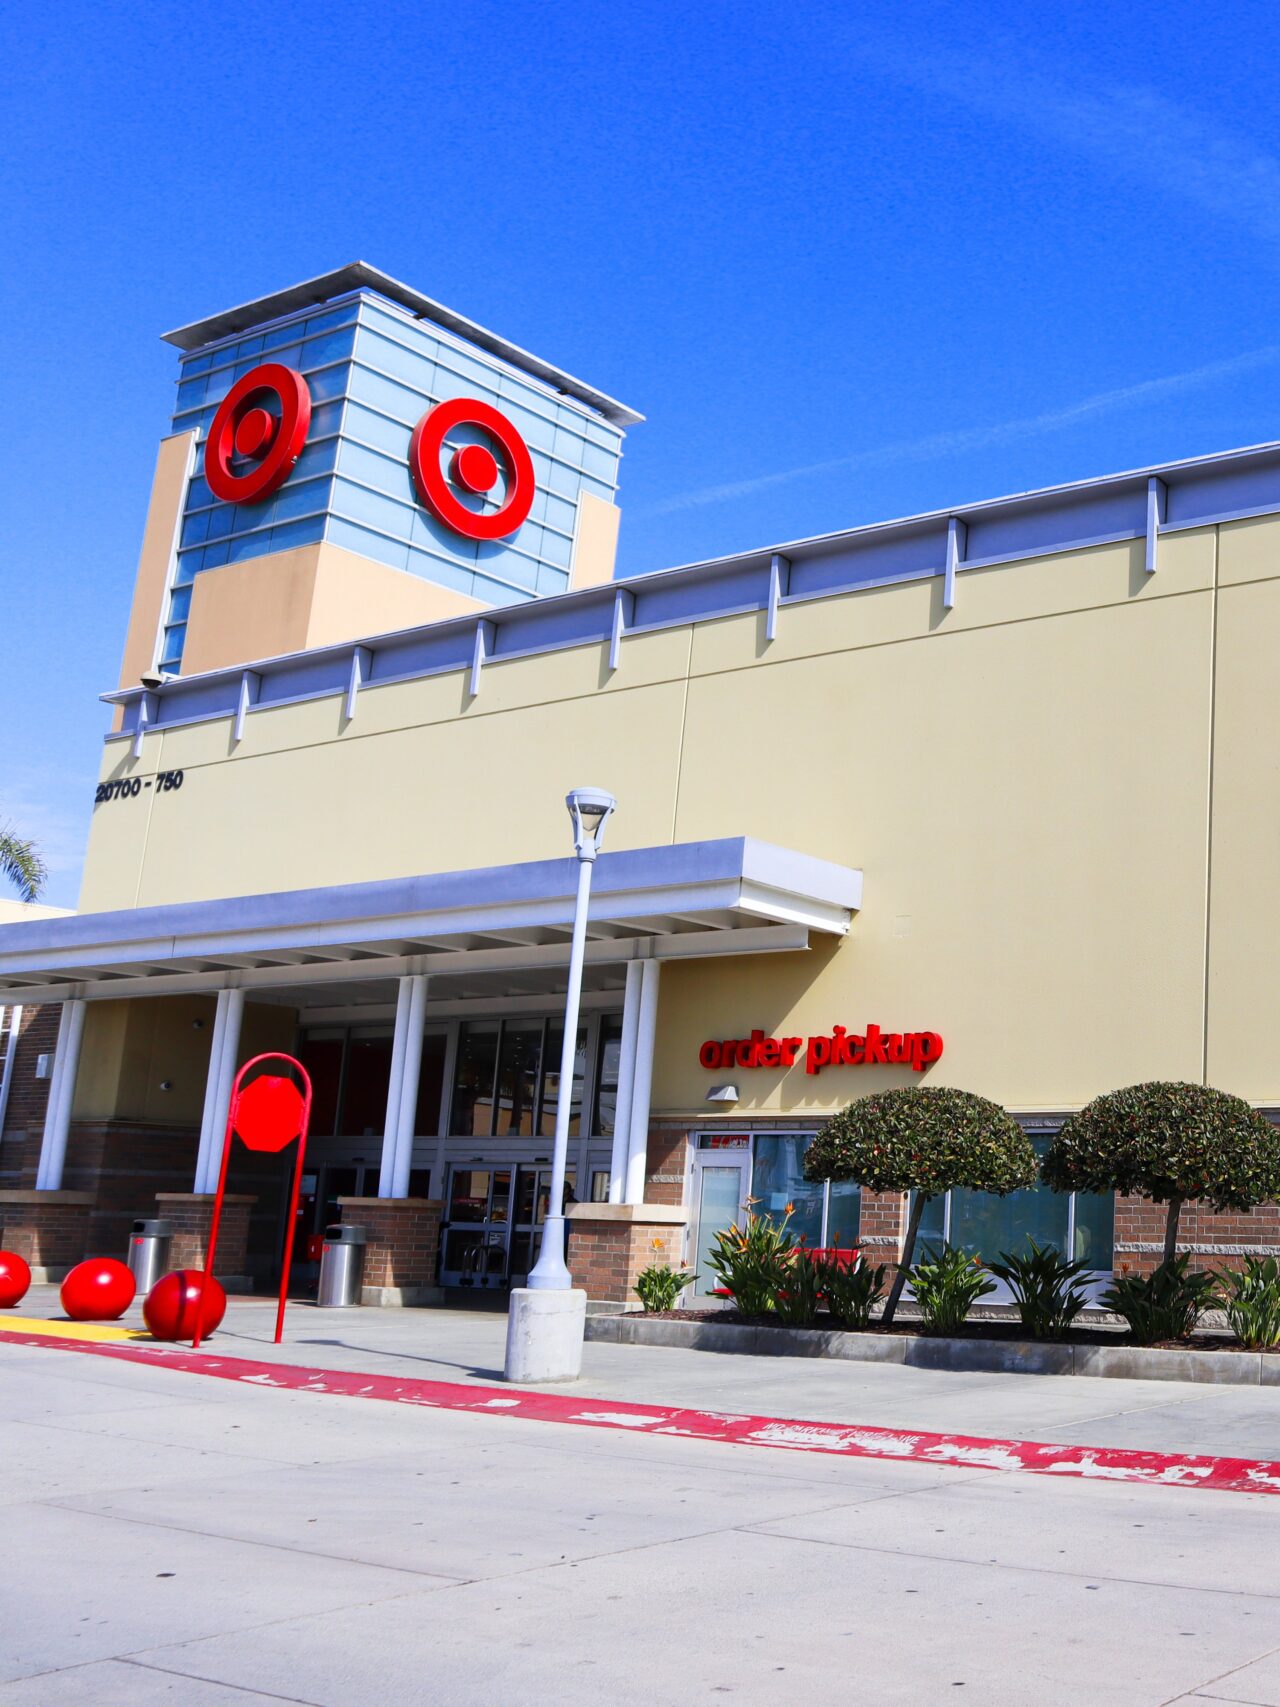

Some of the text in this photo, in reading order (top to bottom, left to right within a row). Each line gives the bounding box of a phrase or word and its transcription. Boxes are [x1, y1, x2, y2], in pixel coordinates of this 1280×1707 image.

[95, 777, 142, 803] 20700
[156, 770, 184, 794] 750
[699, 1024, 943, 1075] order pickup
